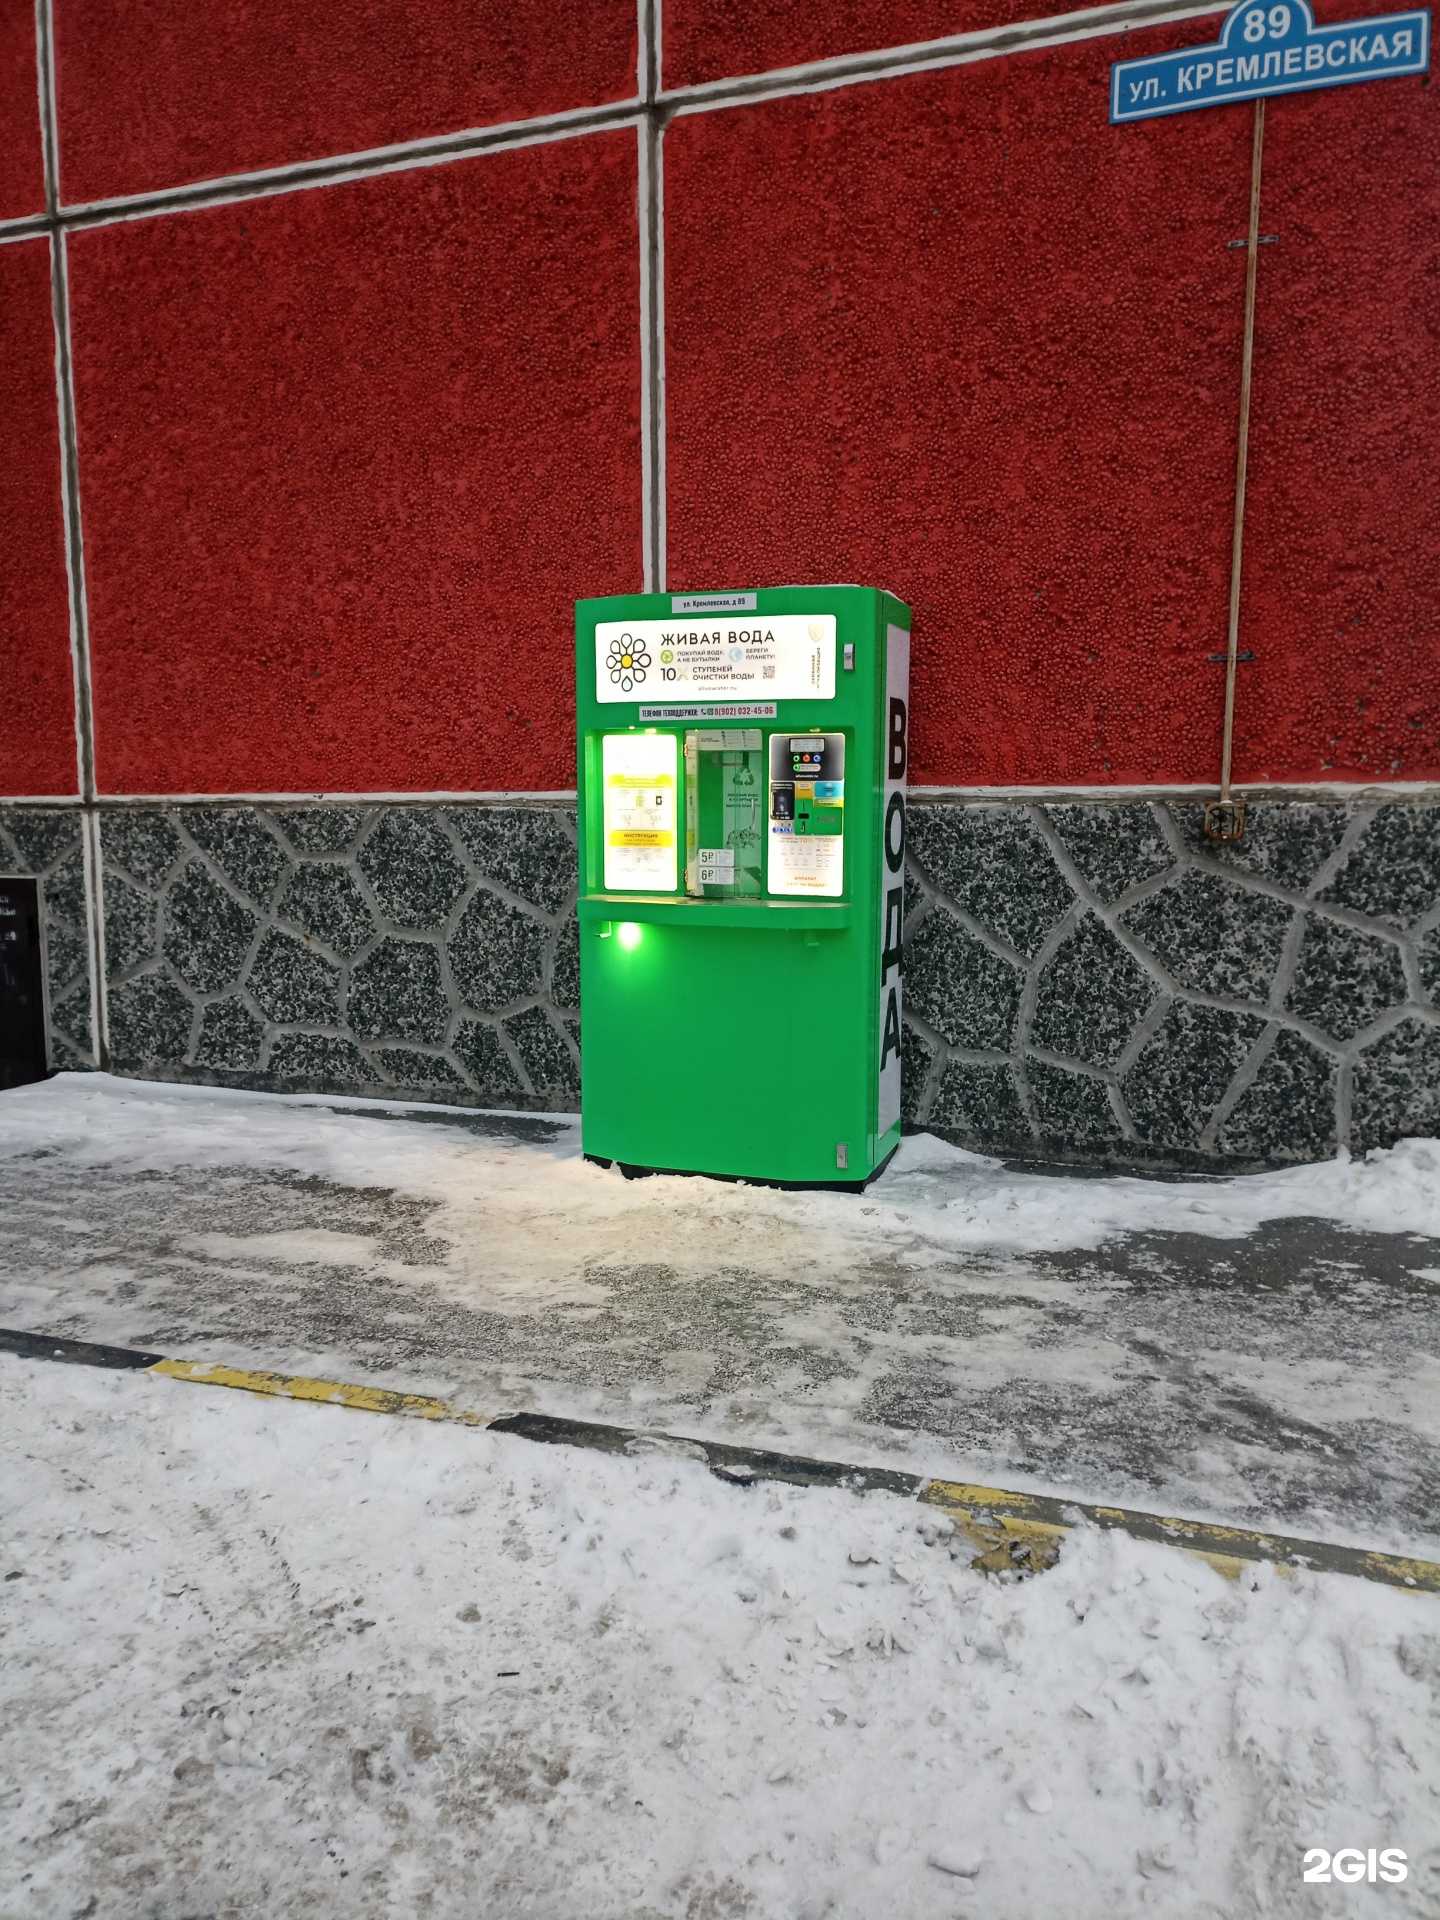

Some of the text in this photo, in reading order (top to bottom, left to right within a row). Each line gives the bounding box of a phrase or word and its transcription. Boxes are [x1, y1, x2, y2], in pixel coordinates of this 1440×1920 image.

[1243, 5, 1291, 43] 89
[1130, 29, 1413, 103] ул. КРЕМЛЕВСКАЯ
[661, 630, 775, 646] ЖИВАЯ ВОДА
[660, 667, 677, 681] 10
[692, 664, 733, 673] СТУПЕНЕЙ
[692, 673, 755, 681] ОЧИСТКИ ВОДЫ
